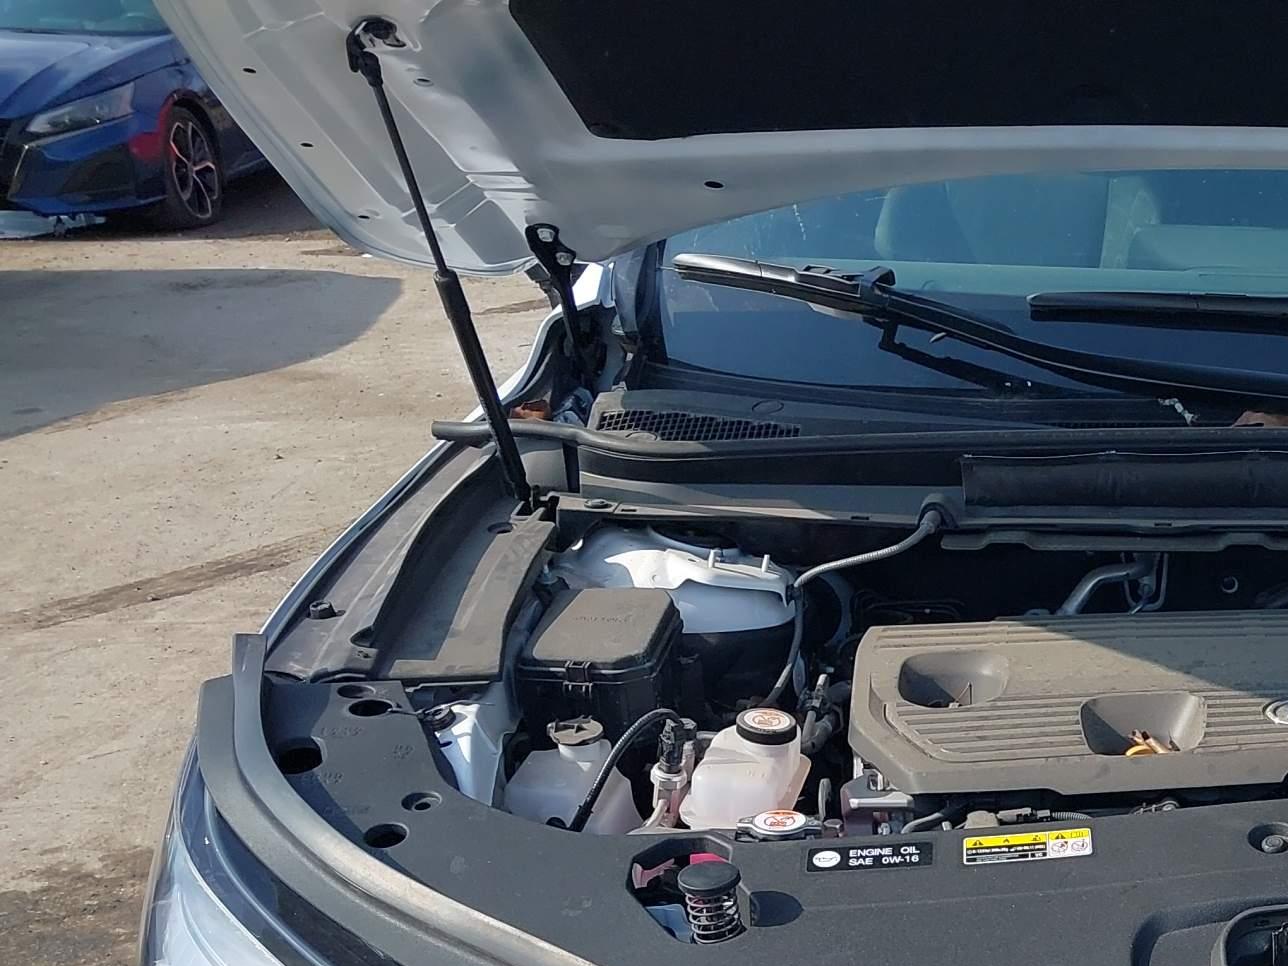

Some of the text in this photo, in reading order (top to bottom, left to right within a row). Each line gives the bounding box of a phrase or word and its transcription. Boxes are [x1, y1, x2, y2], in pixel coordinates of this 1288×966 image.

[848, 845, 921, 858] ENGINE OIL
[848, 855, 920, 867] SAE 0W-16
